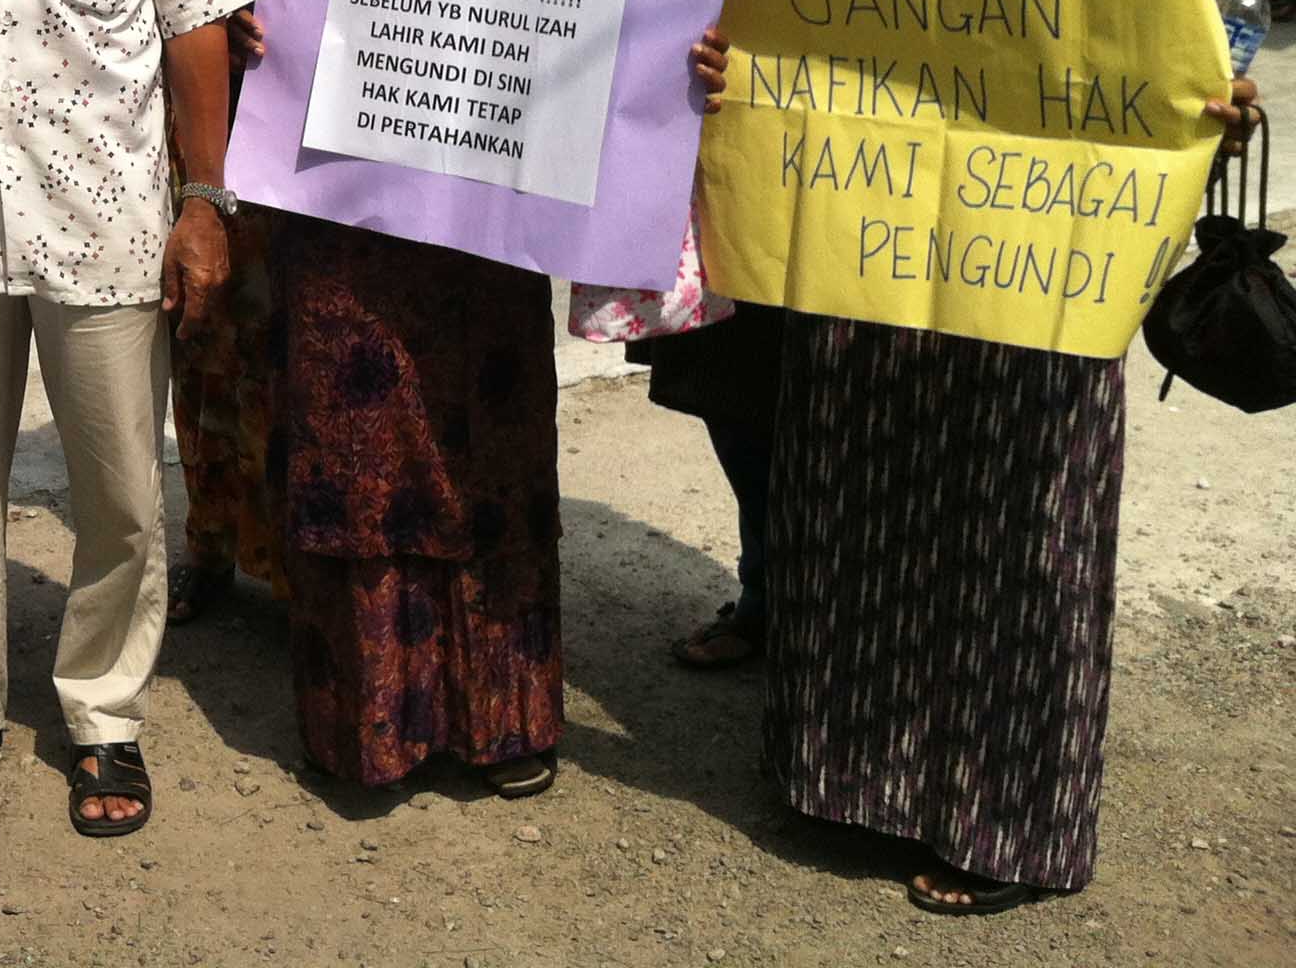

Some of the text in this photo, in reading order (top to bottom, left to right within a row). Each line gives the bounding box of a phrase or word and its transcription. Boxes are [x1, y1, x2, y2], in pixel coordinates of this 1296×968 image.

[370, 22, 530, 62] LAHIR KAMI DAH
[438, 2, 461, 20] YB
[468, 7, 530, 31] NURUL
[535, 17, 576, 39] IZAH
[357, 50, 531, 95] MENGUNDI DI SINI
[750, 54, 1152, 137] NAFIKAN HAK
[362, 82, 522, 125] HAK KAMI TETAP
[357, 112, 524, 159] DI PERTAHANKAN
[782, 131, 1168, 227] KAMI SEBAGAI
[860, 215, 1115, 302] PENGUNDI
